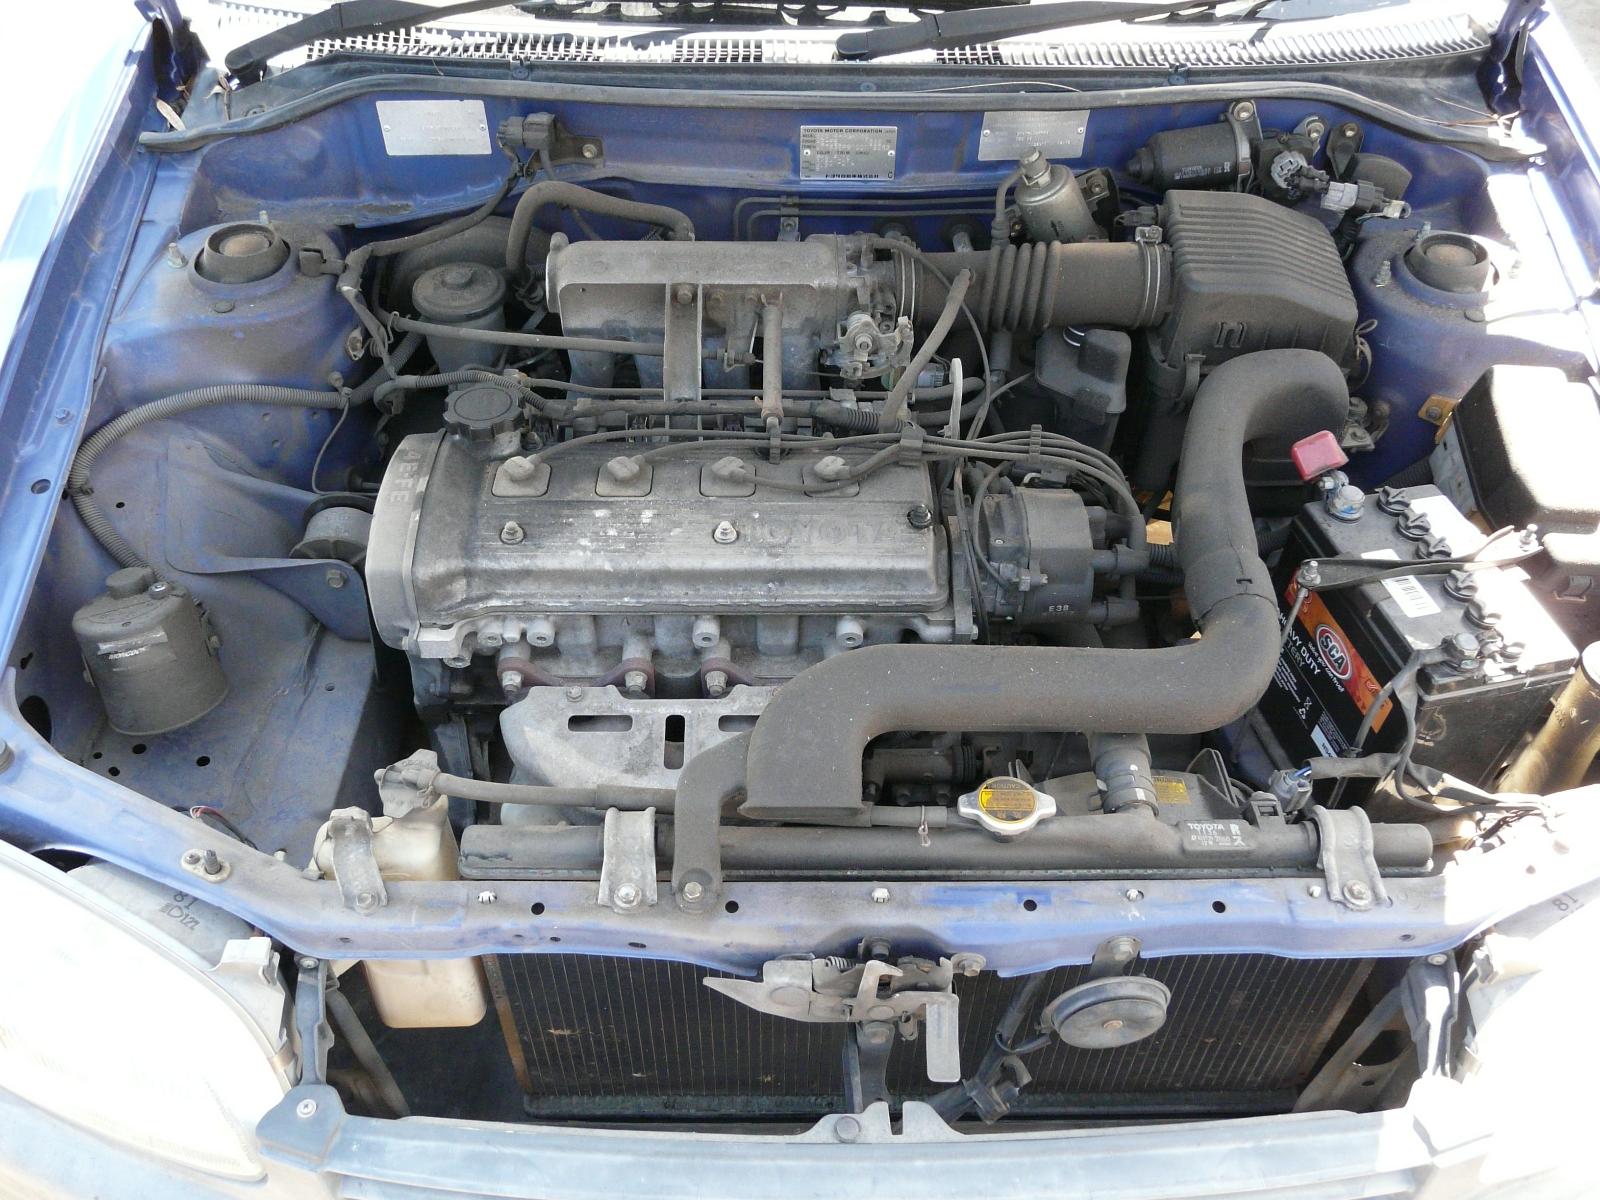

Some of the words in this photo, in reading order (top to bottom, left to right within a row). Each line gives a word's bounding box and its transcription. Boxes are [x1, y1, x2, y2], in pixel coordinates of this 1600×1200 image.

[1279, 612, 1303, 646] HAVY
[1300, 646, 1321, 675] DUTY
[1286, 639, 1306, 668] TERY
[1319, 633, 1347, 673] SCA
[1187, 823, 1226, 831] TOYOTA
